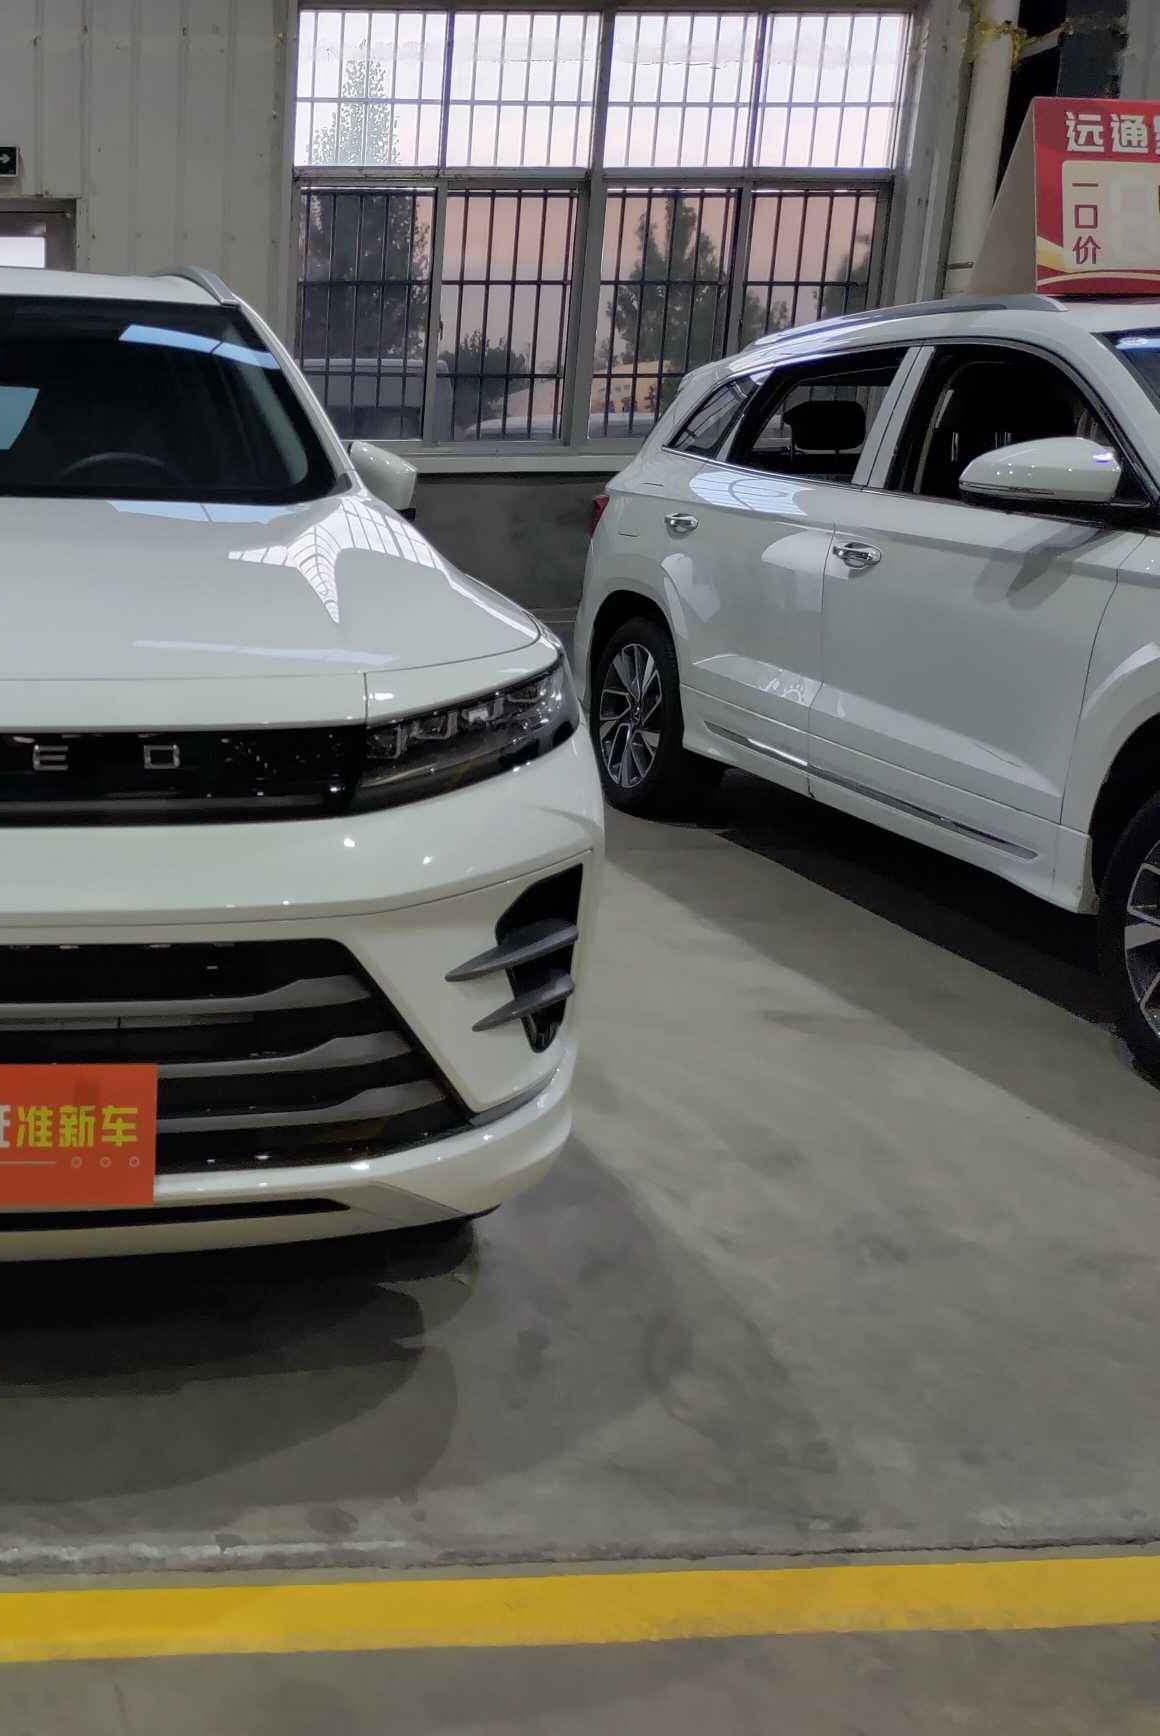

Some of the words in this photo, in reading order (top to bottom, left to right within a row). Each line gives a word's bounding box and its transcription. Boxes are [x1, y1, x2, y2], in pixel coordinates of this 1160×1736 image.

[1066, 112, 1160, 154] 远通
[1072, 183, 1101, 264] 一口价
